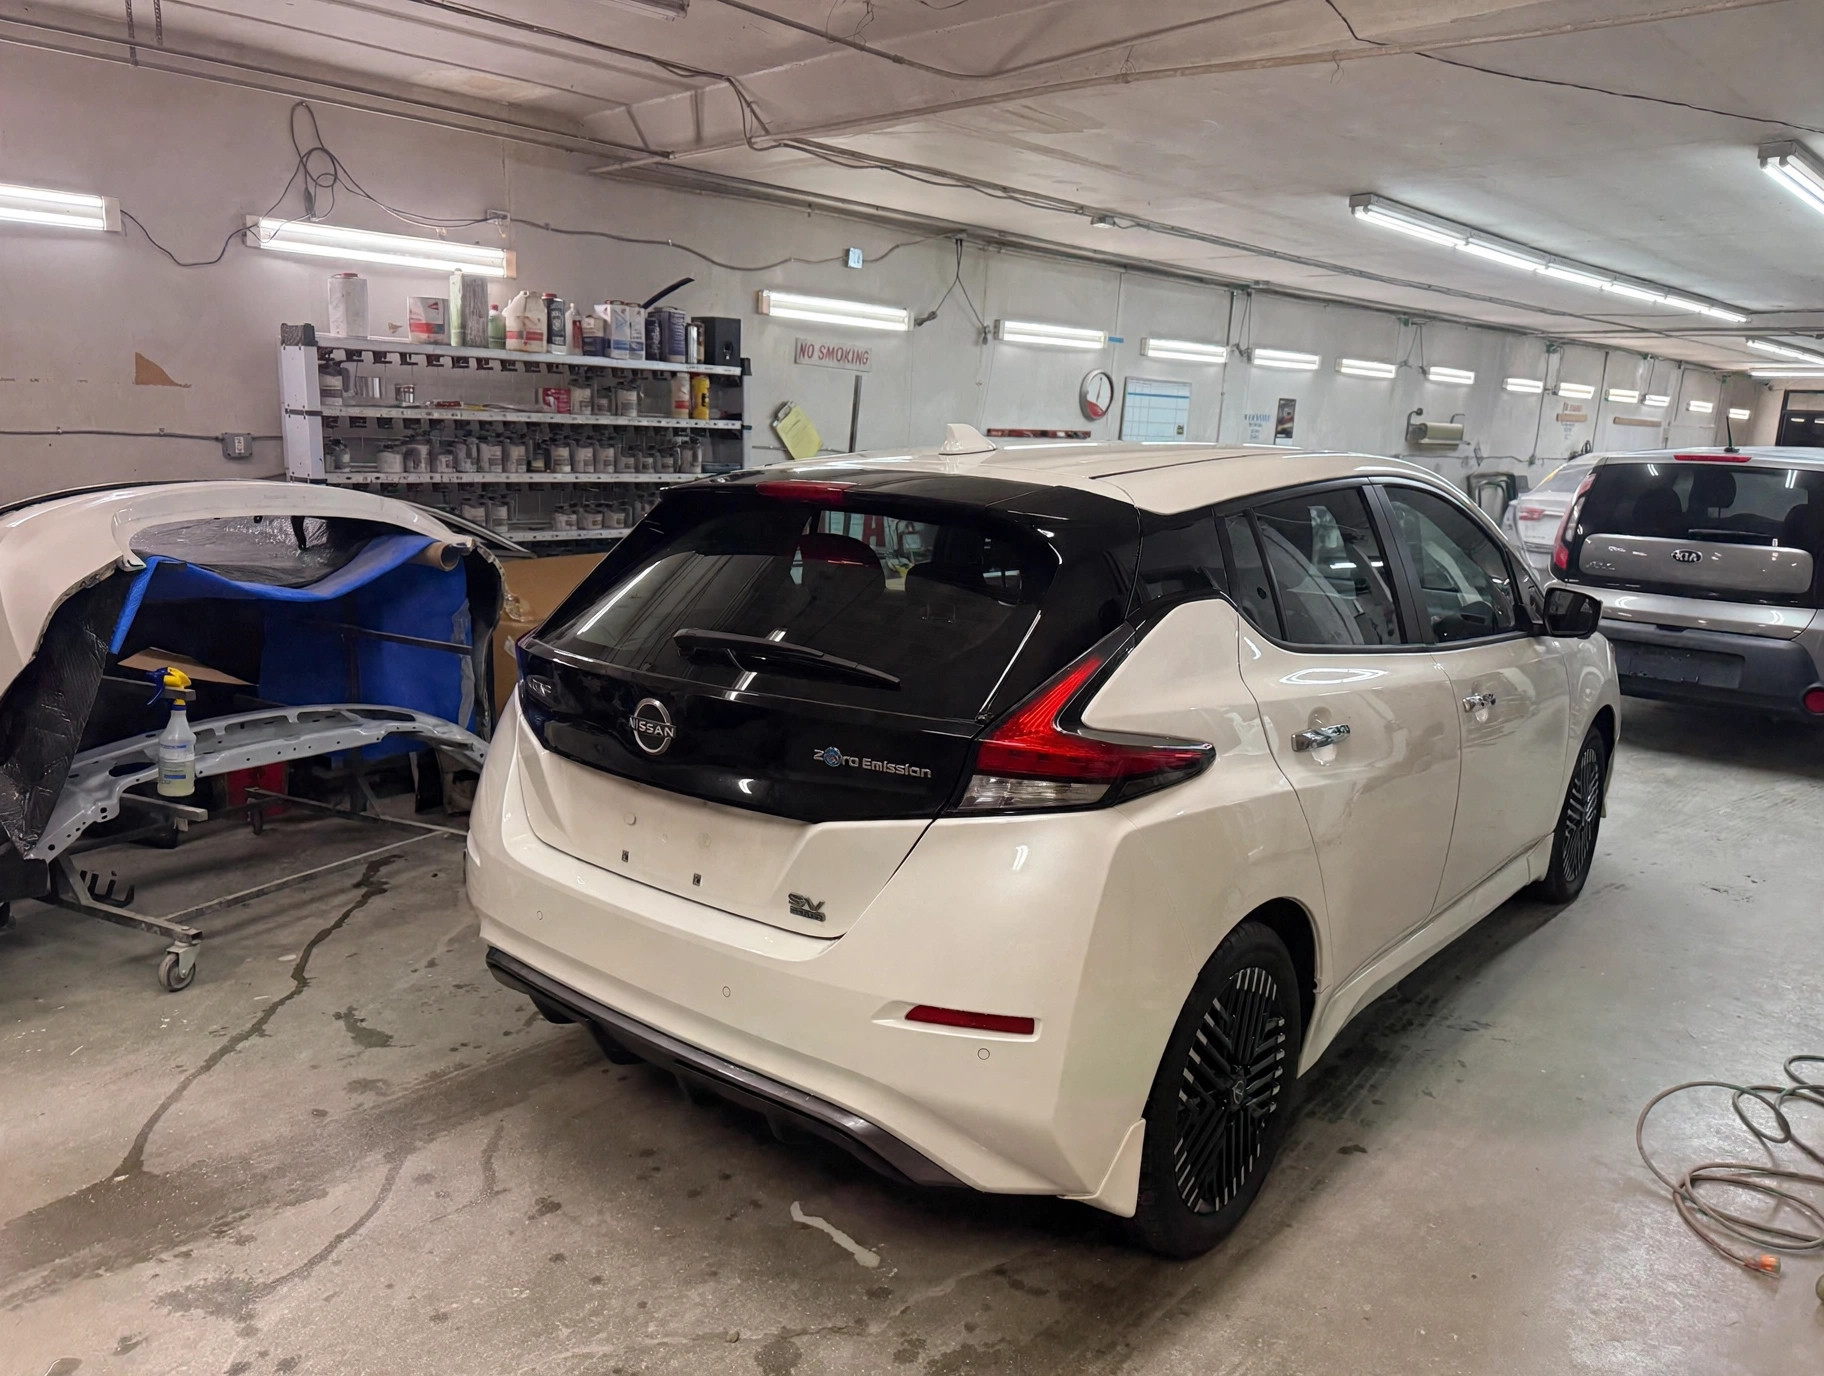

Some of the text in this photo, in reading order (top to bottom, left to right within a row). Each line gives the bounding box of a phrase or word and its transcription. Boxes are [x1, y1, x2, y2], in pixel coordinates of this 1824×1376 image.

[798, 342, 869, 366] NO SMOKING
[628, 716, 676, 738] NISSAN
[862, 757, 932, 778] Emission
[788, 893, 826, 912] SV
